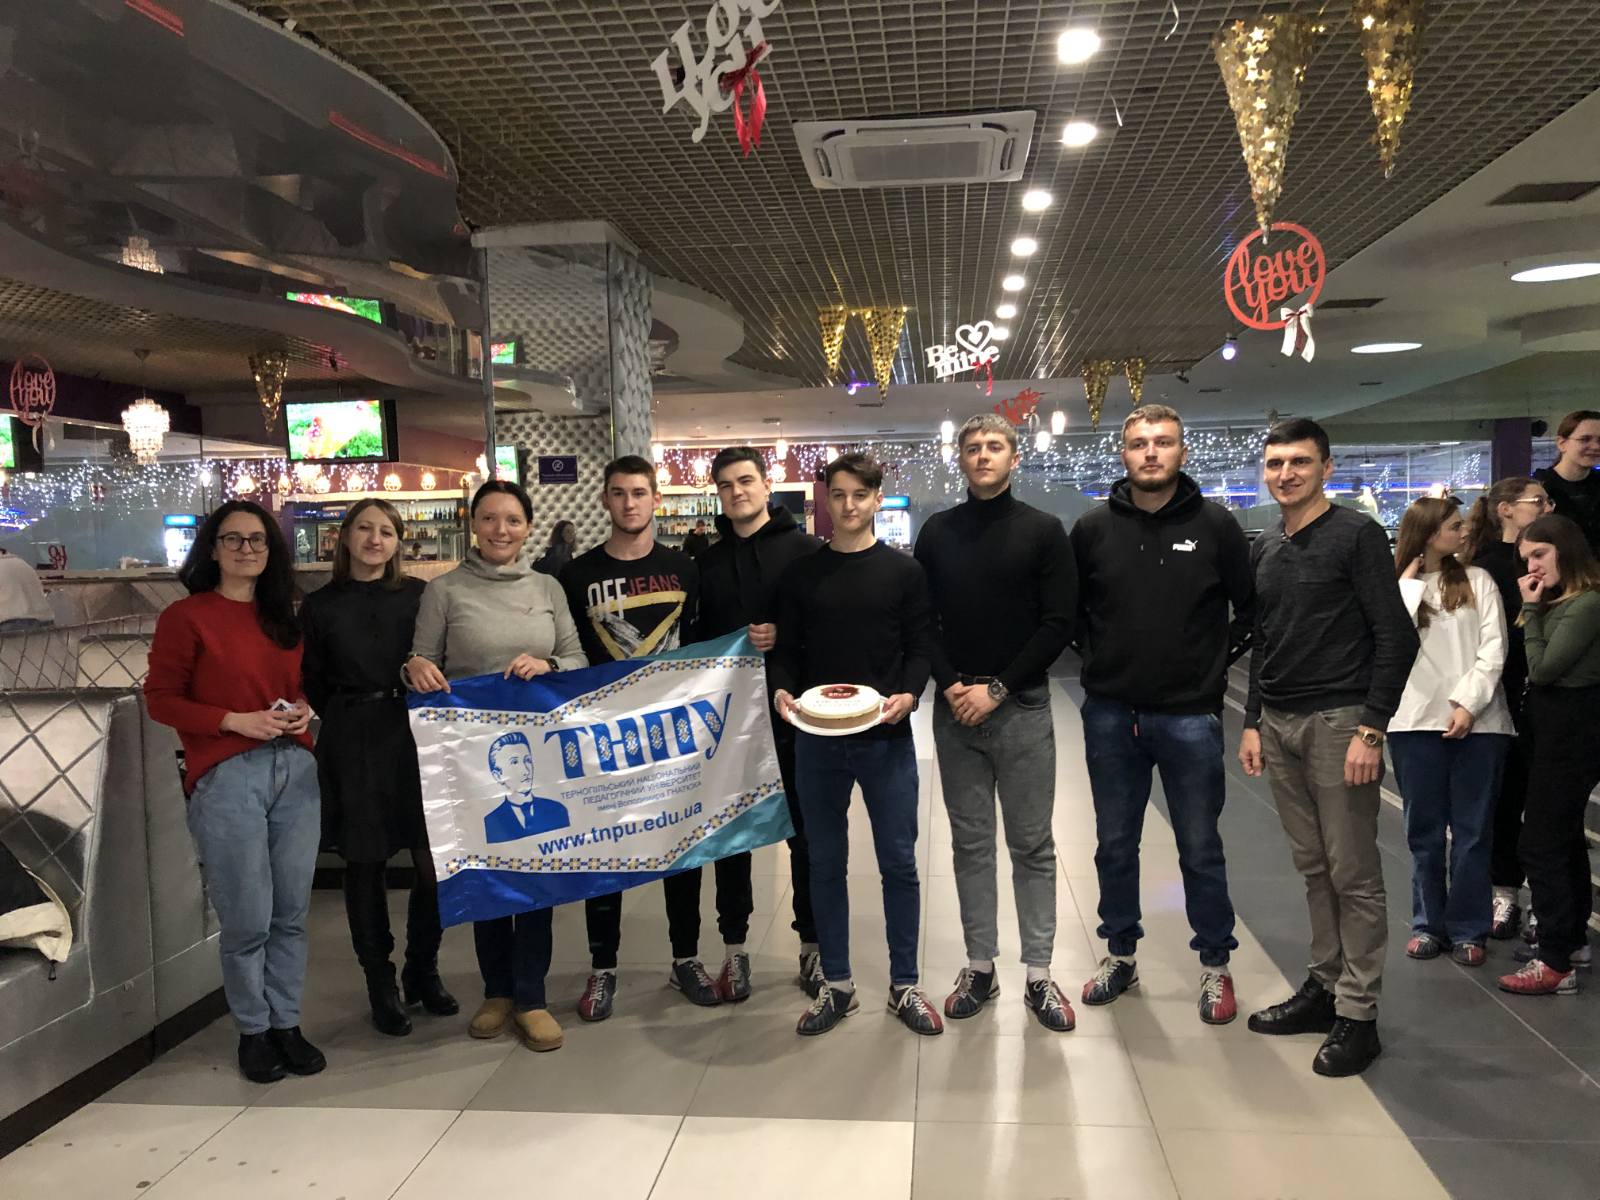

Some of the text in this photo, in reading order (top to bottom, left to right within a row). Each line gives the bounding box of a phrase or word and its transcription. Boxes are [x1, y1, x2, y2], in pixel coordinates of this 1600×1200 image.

[1231, 241, 1317, 288] love
[1245, 268, 1317, 322] you
[925, 344, 959, 368] Be
[935, 345, 1000, 378] mine
[626, 575, 682, 597] JEANS
[544, 693, 732, 779] ТНПУ
[538, 801, 702, 856] www.tnpu.edu.ua
